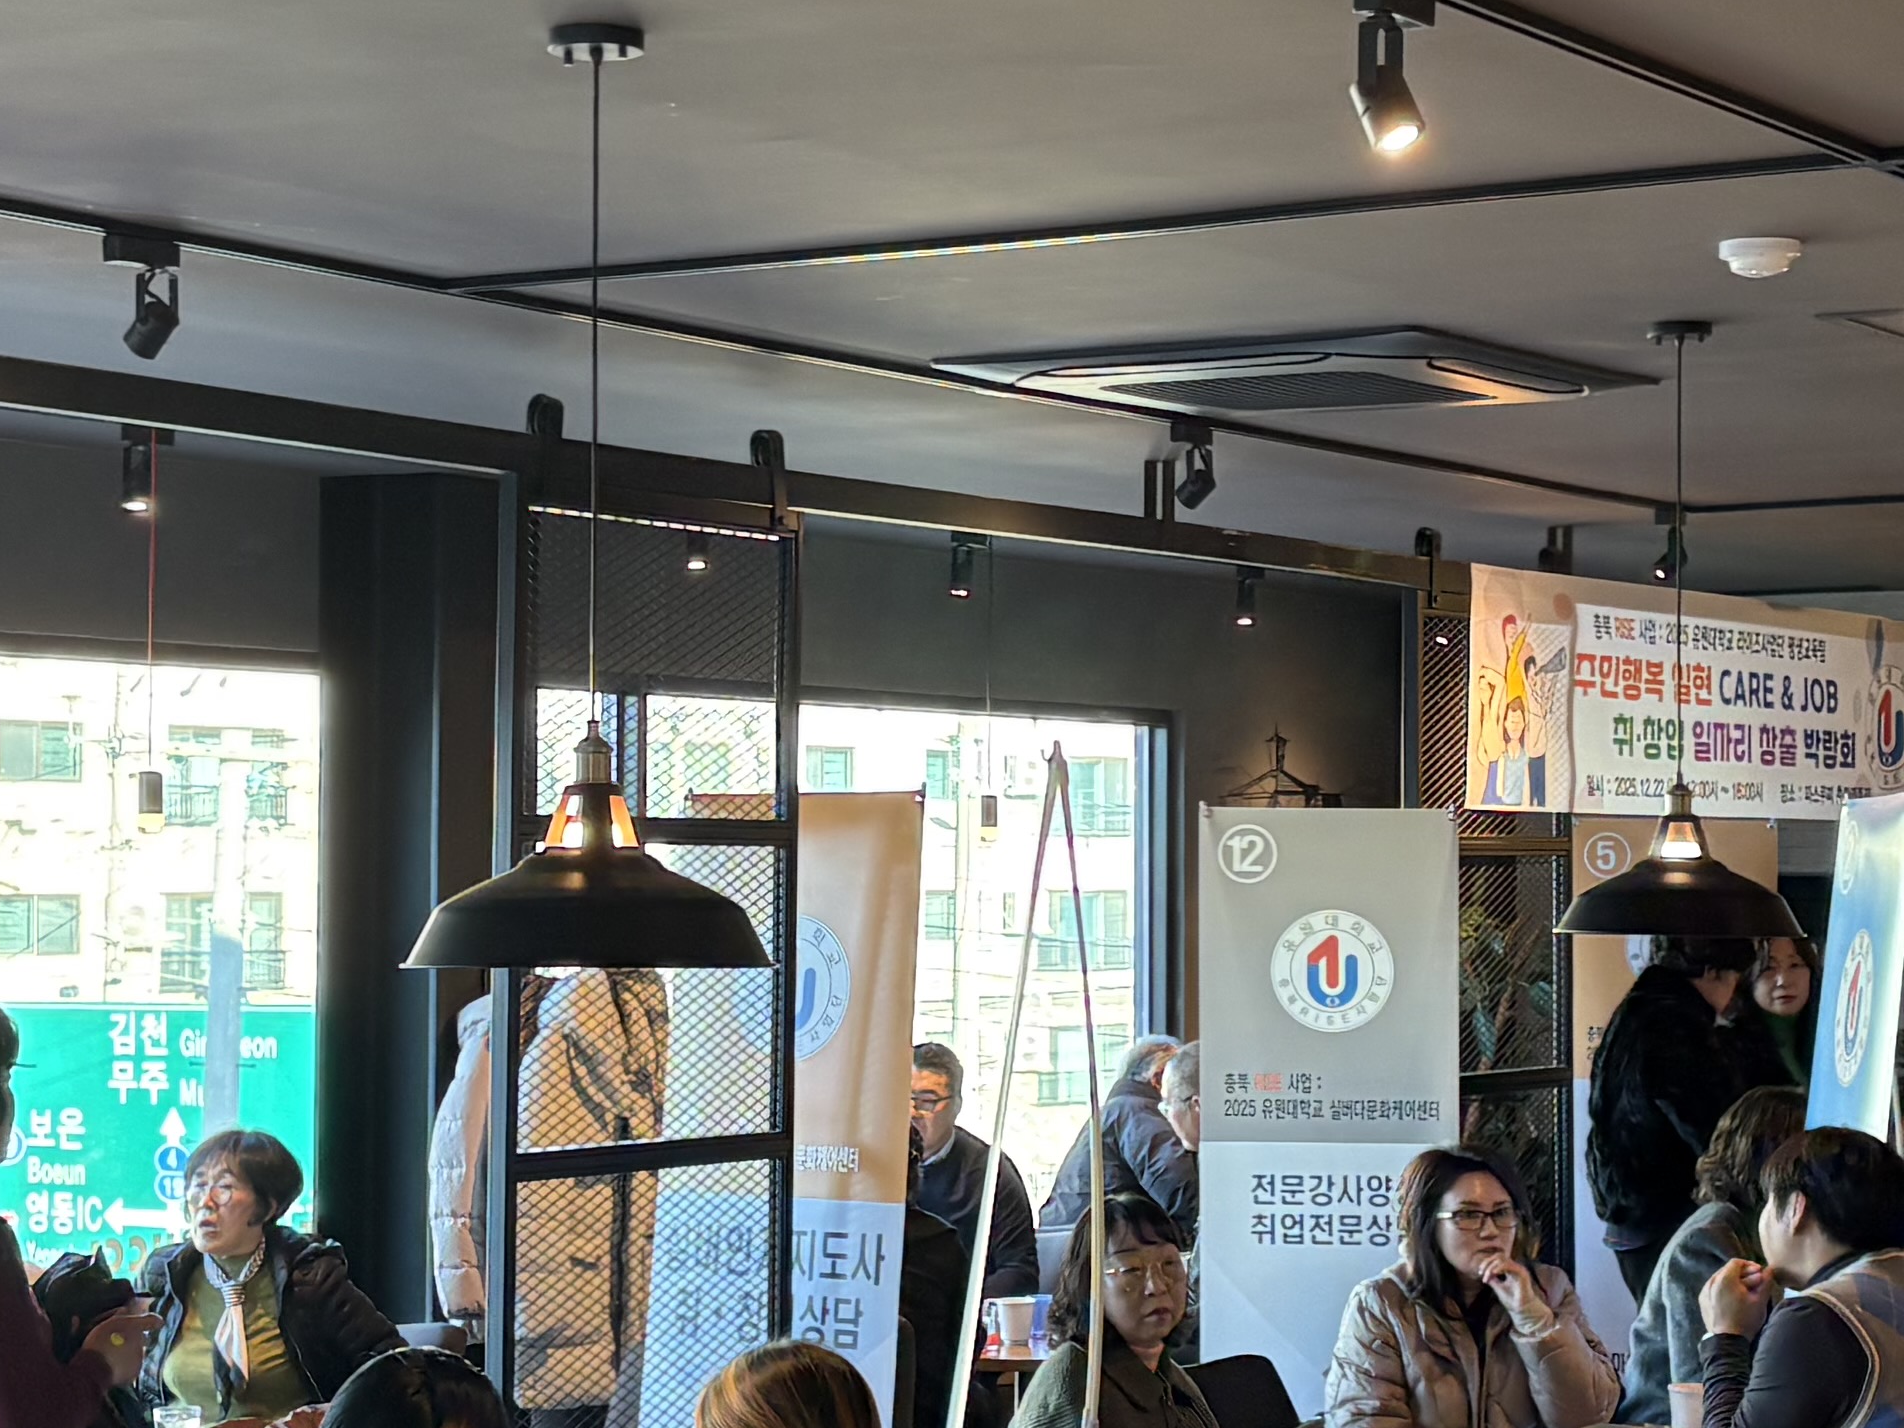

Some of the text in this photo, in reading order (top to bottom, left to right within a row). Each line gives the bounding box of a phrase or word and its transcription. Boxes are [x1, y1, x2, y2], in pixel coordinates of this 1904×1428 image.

[1575, 652, 1665, 704] 주민행복
[1719, 669, 1775, 709] CARE
[1780, 674, 1796, 711] &
[1799, 676, 1840, 716] JOB
[1758, 723, 1799, 768] 창출
[1802, 728, 1857, 771] 박람회
[107, 1010, 170, 1057] 김천
[107, 1060, 170, 1105] 무주
[1224, 1073, 1251, 1094] 충북
[1288, 1073, 1312, 1095] 사업
[27, 1106, 86, 1152] 보은
[1224, 1098, 1441, 1121] 2025 유원대학교 실버다문화케어센터
[26, 1155, 87, 1187] Boeun
[1250, 1174, 1395, 1207] 전문강사양
[25, 1189, 104, 1235] 영동IC
[791, 1230, 886, 1287] 지도사
[798, 1294, 864, 1351] 상담
